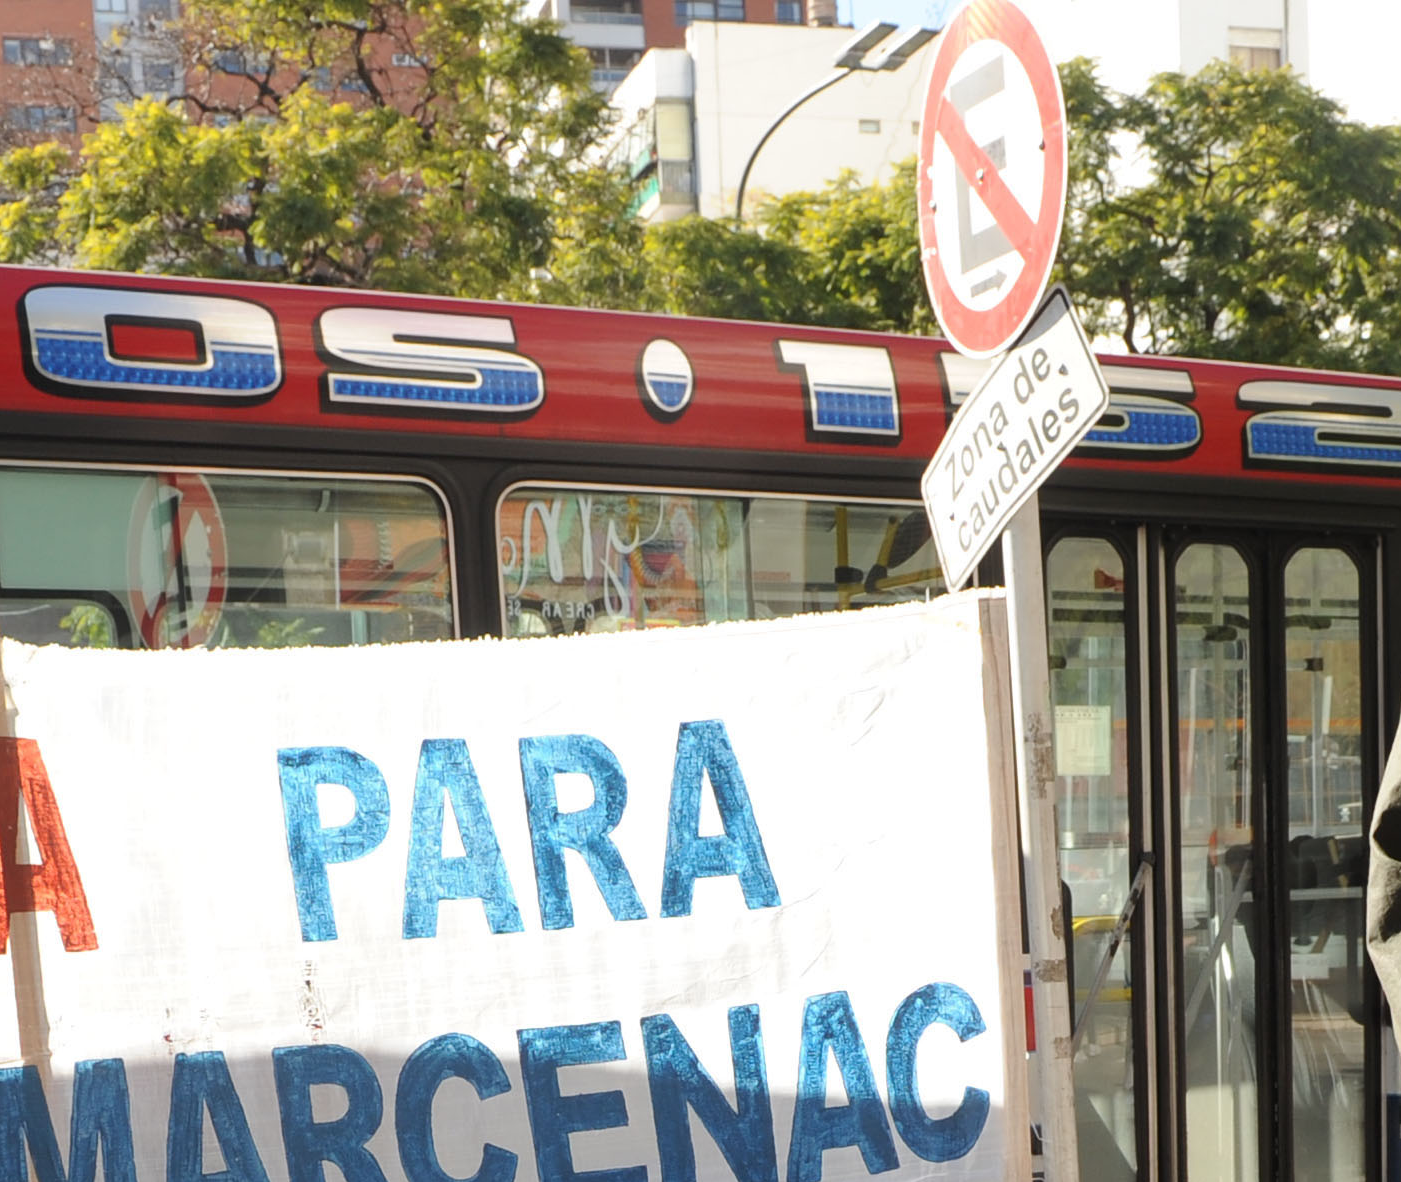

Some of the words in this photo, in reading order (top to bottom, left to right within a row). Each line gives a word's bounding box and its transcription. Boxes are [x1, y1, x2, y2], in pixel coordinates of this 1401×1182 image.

[1014, 348, 1051, 404] de
[958, 387, 1080, 552] caudales
[277, 719, 782, 942] PARA
